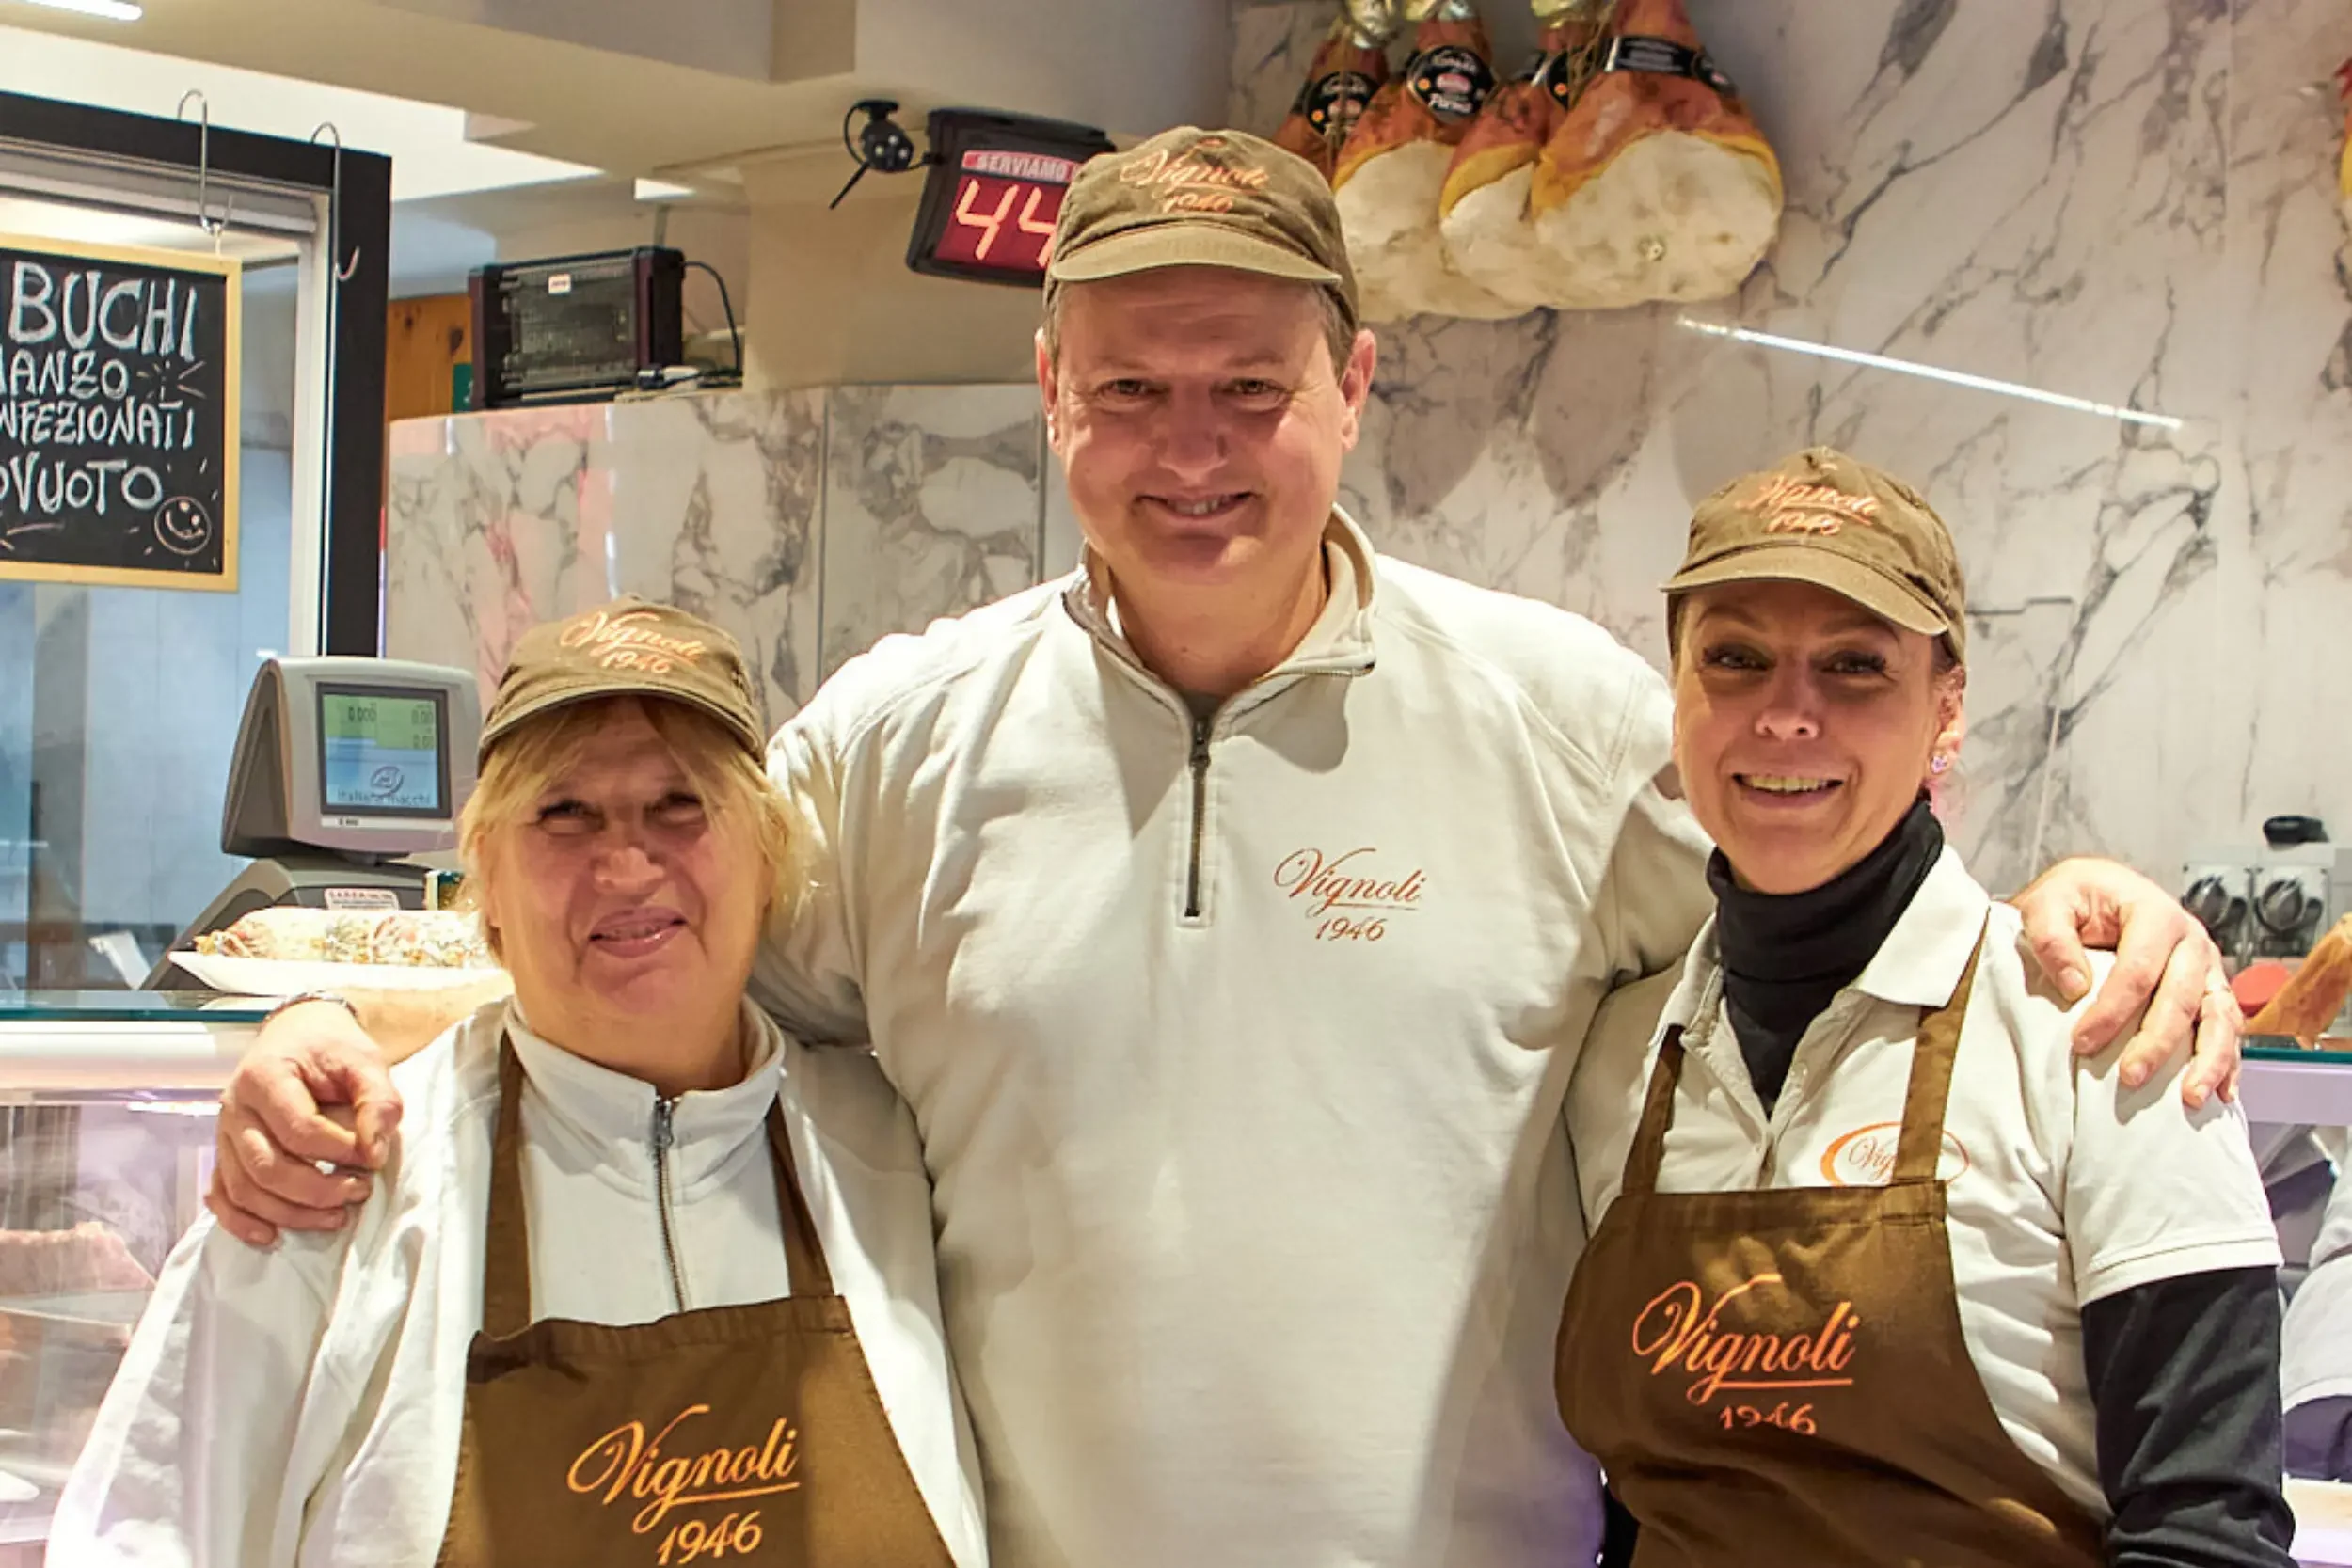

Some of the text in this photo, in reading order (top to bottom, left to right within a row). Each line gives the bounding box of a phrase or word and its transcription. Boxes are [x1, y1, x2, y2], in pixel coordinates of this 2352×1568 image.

[976, 153, 1069, 182] SERVIAMO
[9, 260, 198, 362] BUCHI
[1274, 847, 1426, 918] Vignoli
[1314, 915, 1388, 942] 1946
[1632, 1273, 1860, 1406] Vignoli
[566, 1403, 801, 1534] Vignoli
[657, 1510, 763, 1566] 1946
